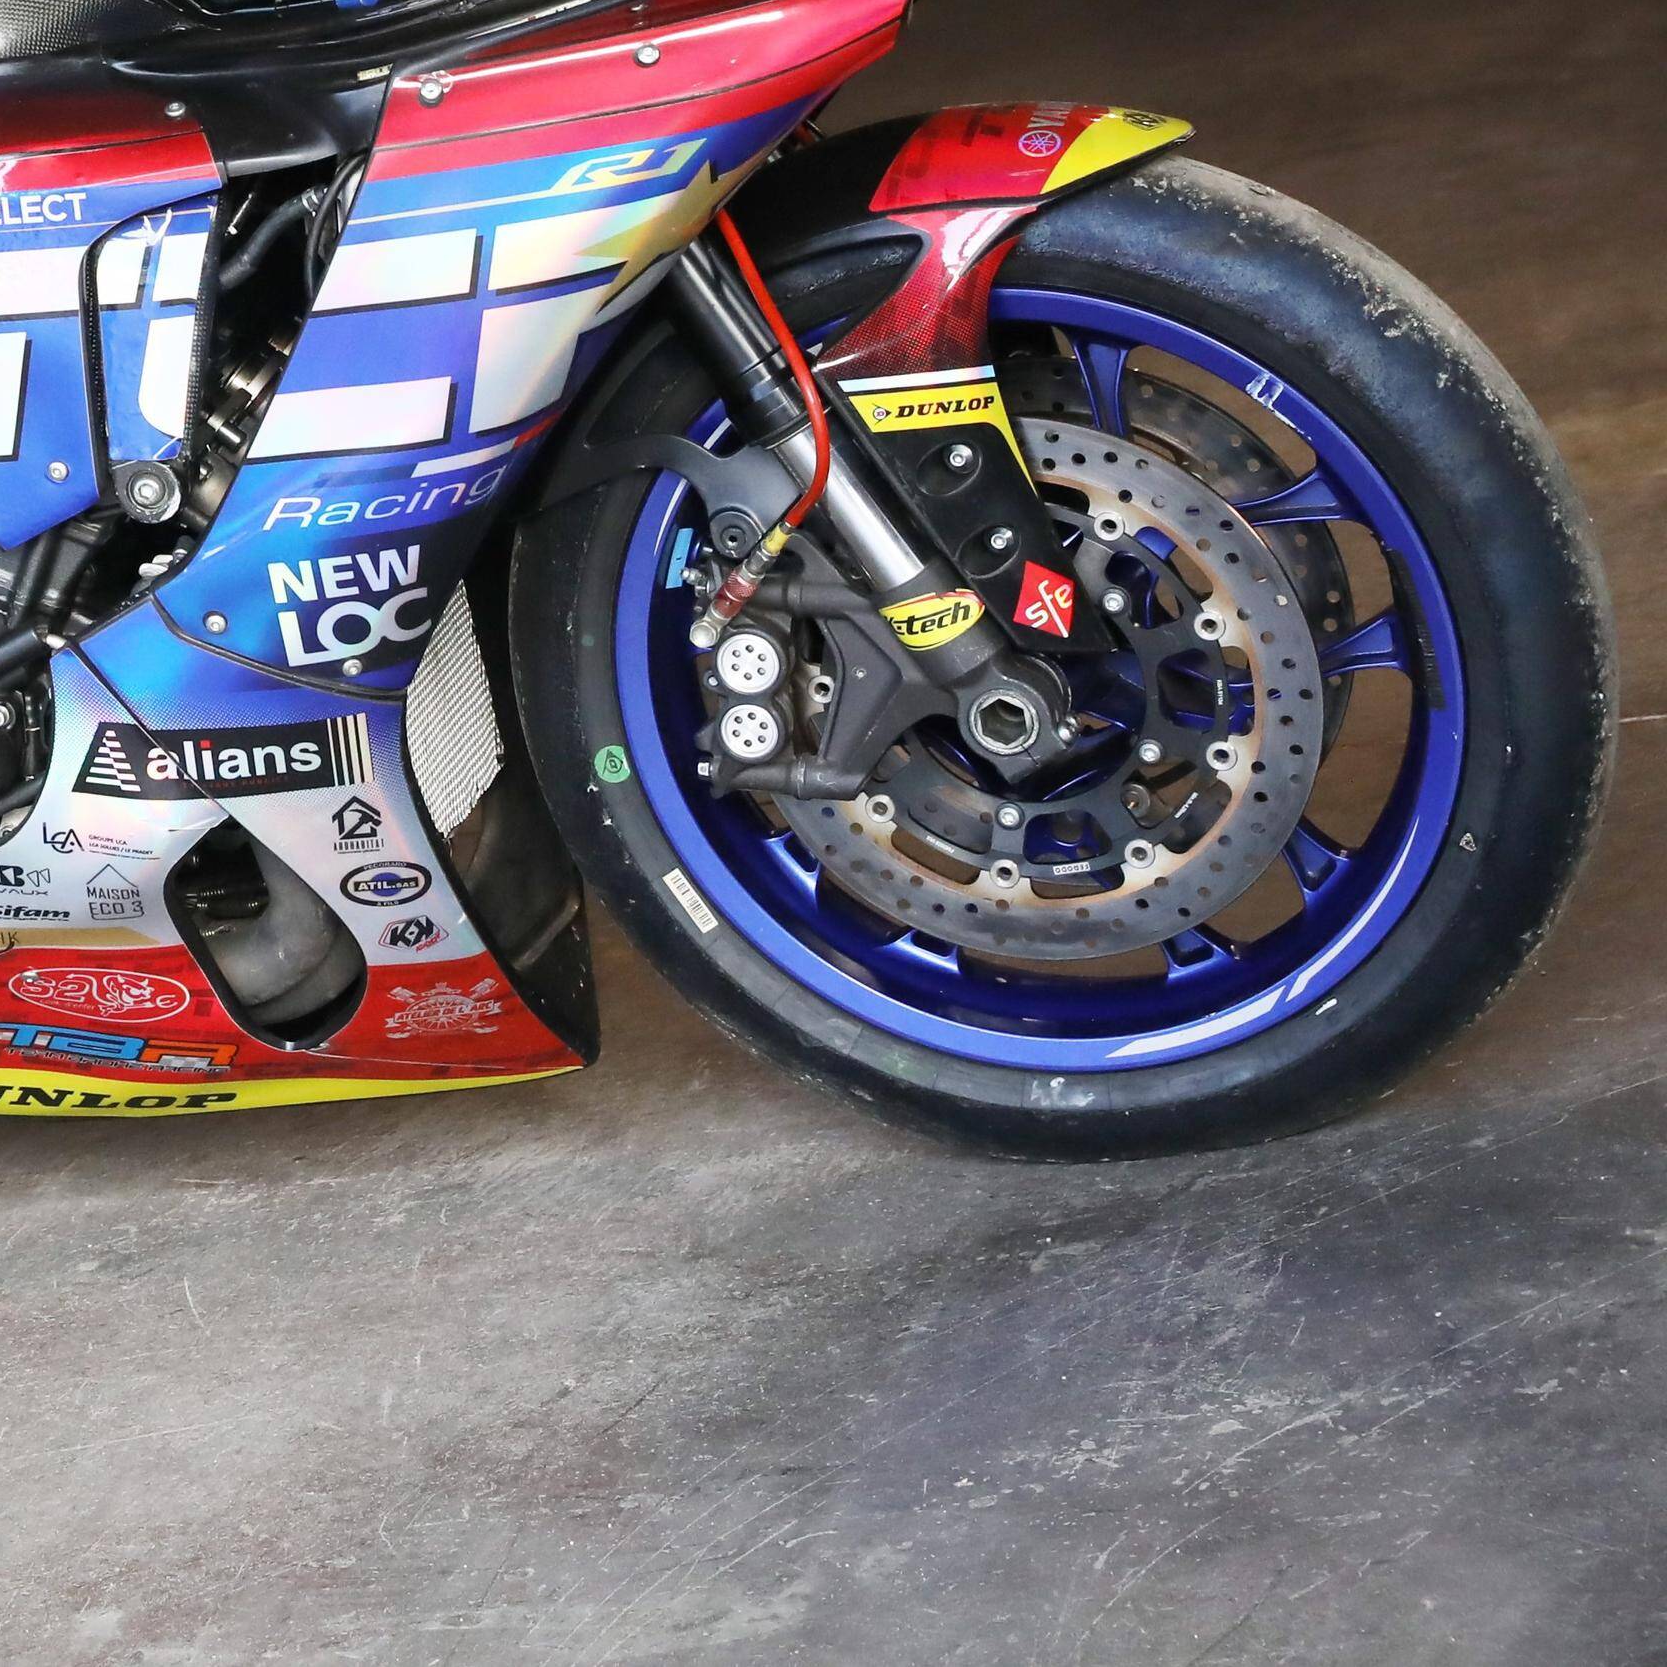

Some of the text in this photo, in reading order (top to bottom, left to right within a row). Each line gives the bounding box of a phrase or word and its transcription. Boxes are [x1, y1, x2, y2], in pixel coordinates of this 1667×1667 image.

[895, 394, 996, 420] DUNLOP
[262, 465, 507, 533] Racing
[267, 544, 421, 604] NEW
[275, 587, 433, 668] LOC
[1024, 579, 1074, 639] sfe
[146, 739, 322, 781] alians
[86, 885, 141, 901] MAISON
[89, 901, 126, 917] ECO
